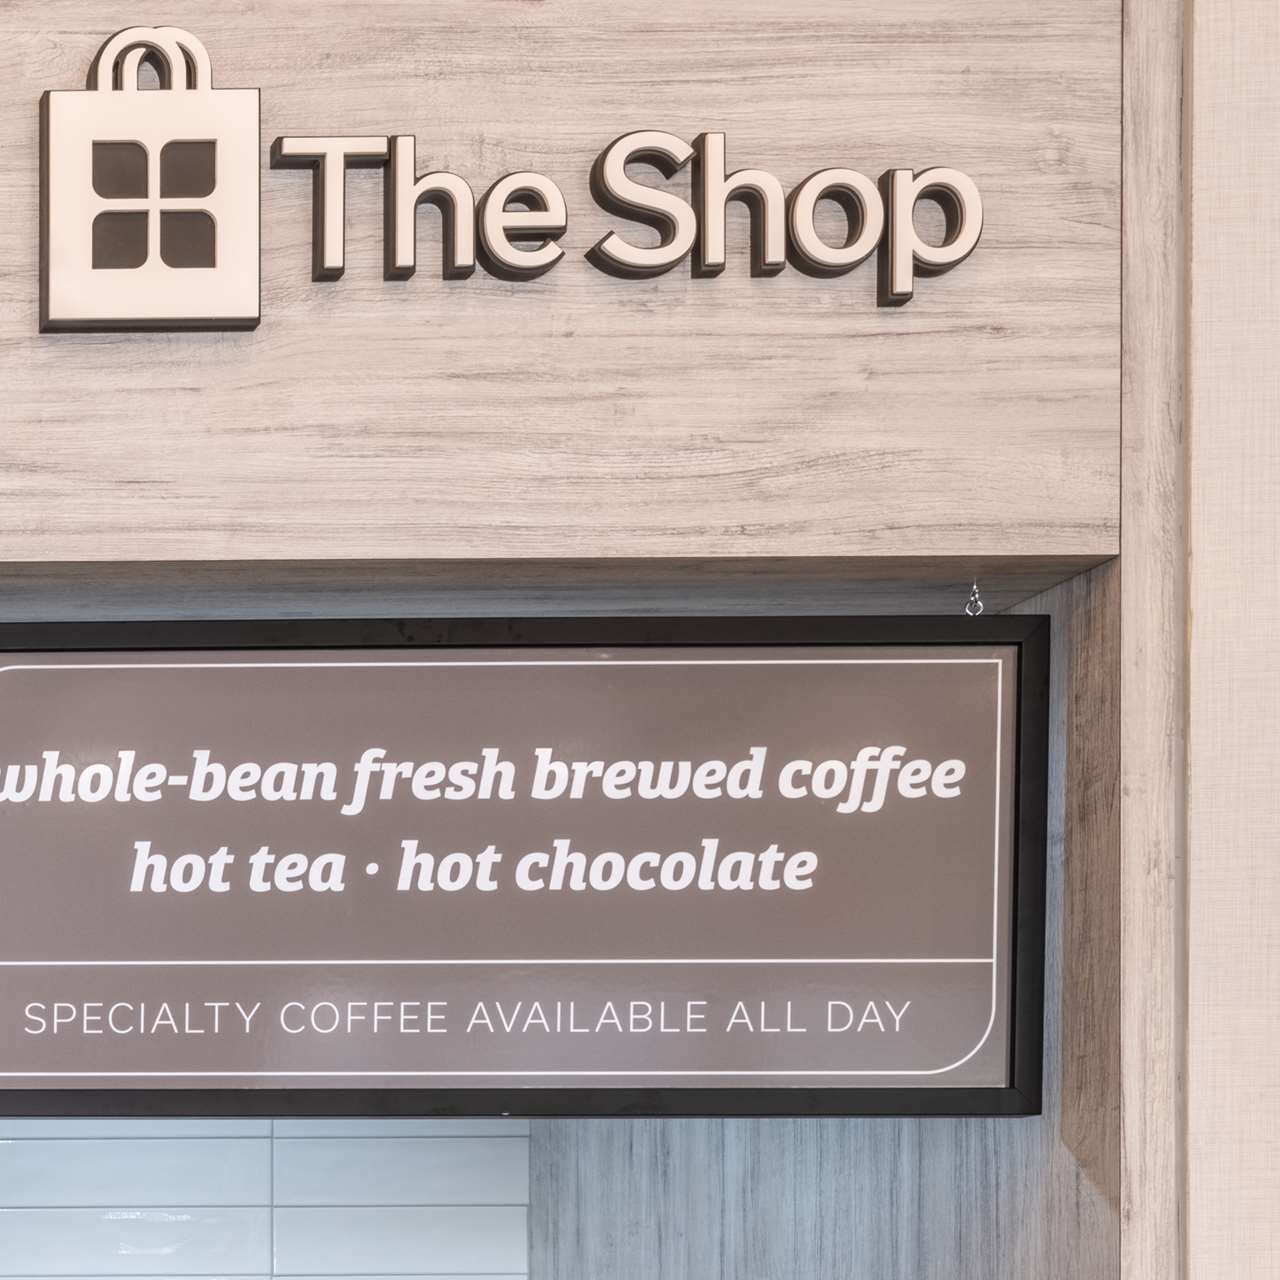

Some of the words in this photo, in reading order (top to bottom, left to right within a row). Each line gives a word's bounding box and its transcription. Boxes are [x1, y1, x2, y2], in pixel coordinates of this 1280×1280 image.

[271, 132, 567, 281] The
[586, 129, 984, 307] Shop
[341, 746, 517, 815] fresh
[532, 746, 763, 802] brewed
[775, 744, 966, 813] coffee
[130, 841, 233, 894] hot
[247, 848, 346, 892] tea
[397, 840, 499, 893] hot
[514, 839, 819, 892] chocolate
[23, 1001, 262, 1035] SPECIALTY
[279, 1001, 449, 1034] COFFEE
[466, 1000, 707, 1034] AVAILABLE
[726, 1000, 807, 1033] ALL
[827, 1000, 912, 1033] DAY
